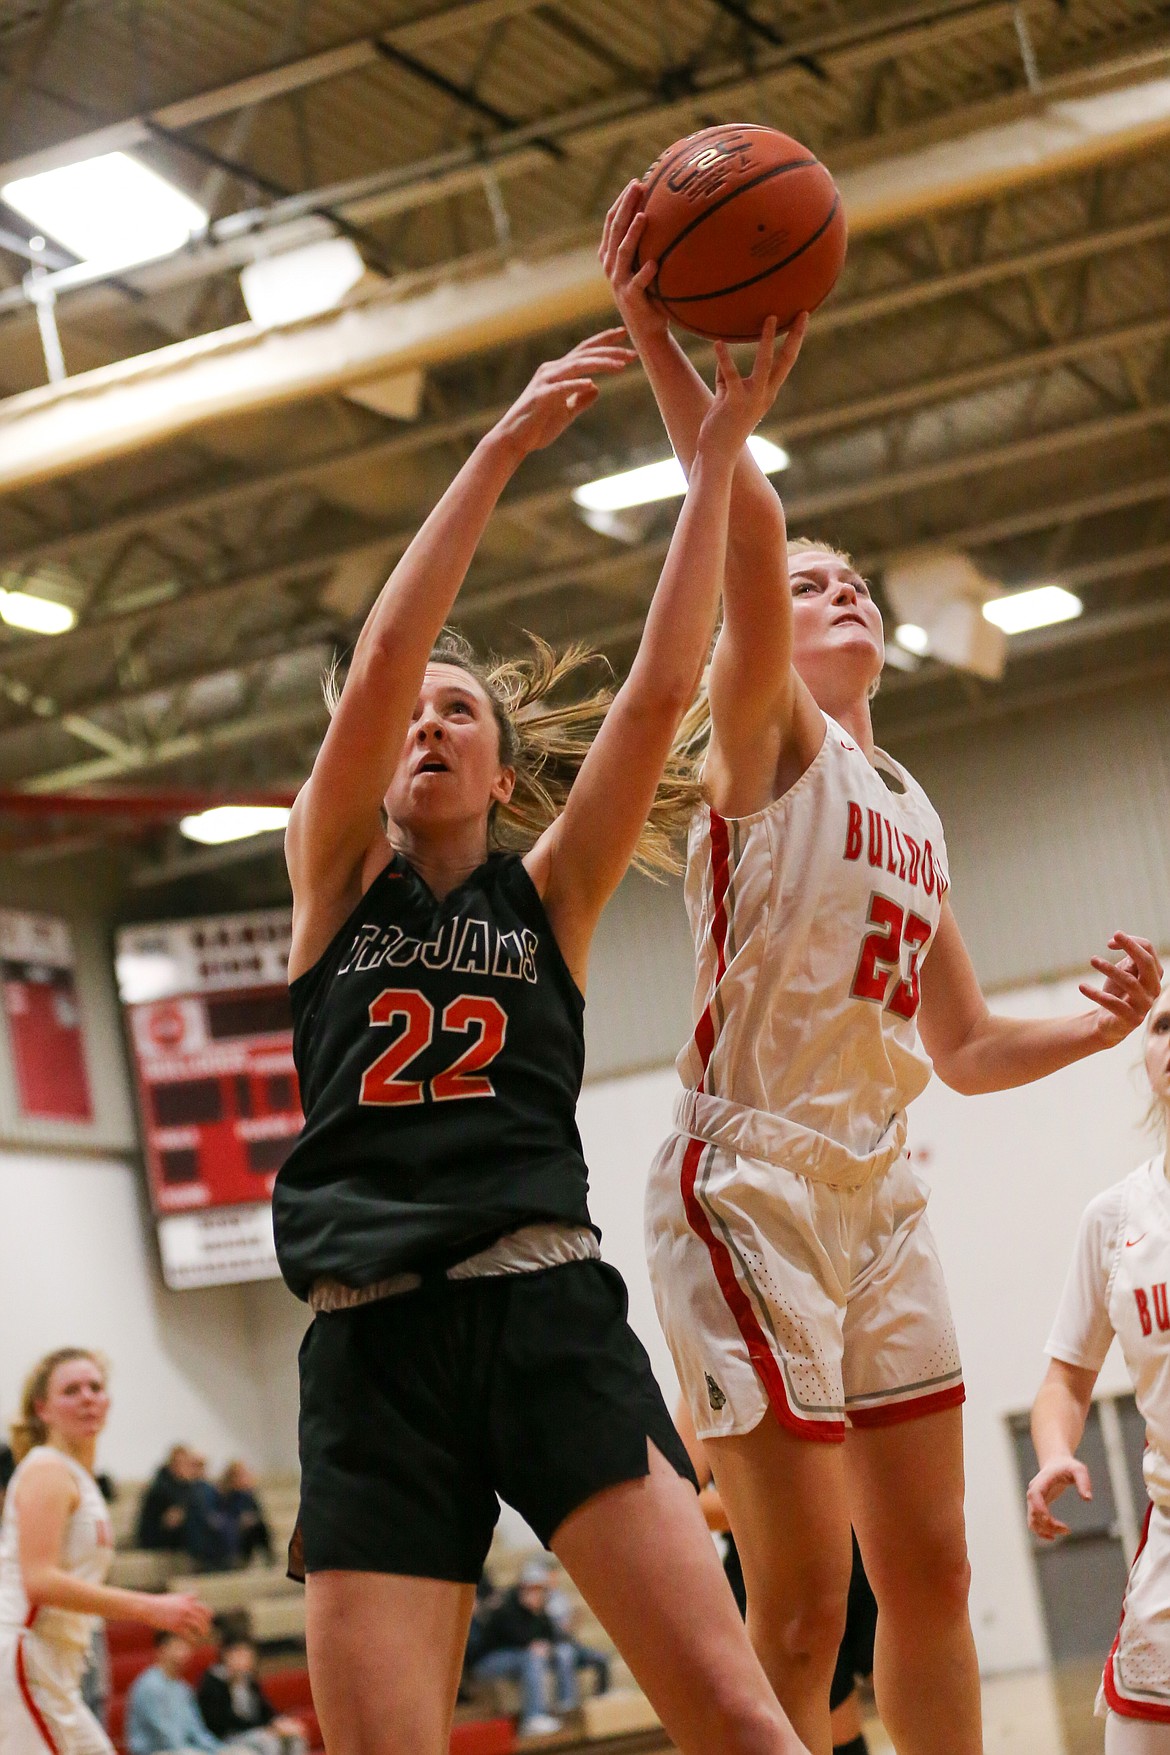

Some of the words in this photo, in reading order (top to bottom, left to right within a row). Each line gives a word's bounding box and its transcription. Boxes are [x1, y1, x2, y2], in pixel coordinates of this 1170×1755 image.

[337, 915, 539, 985] TROJANS
[848, 890, 932, 1022] 23
[358, 987, 509, 1107] 22
